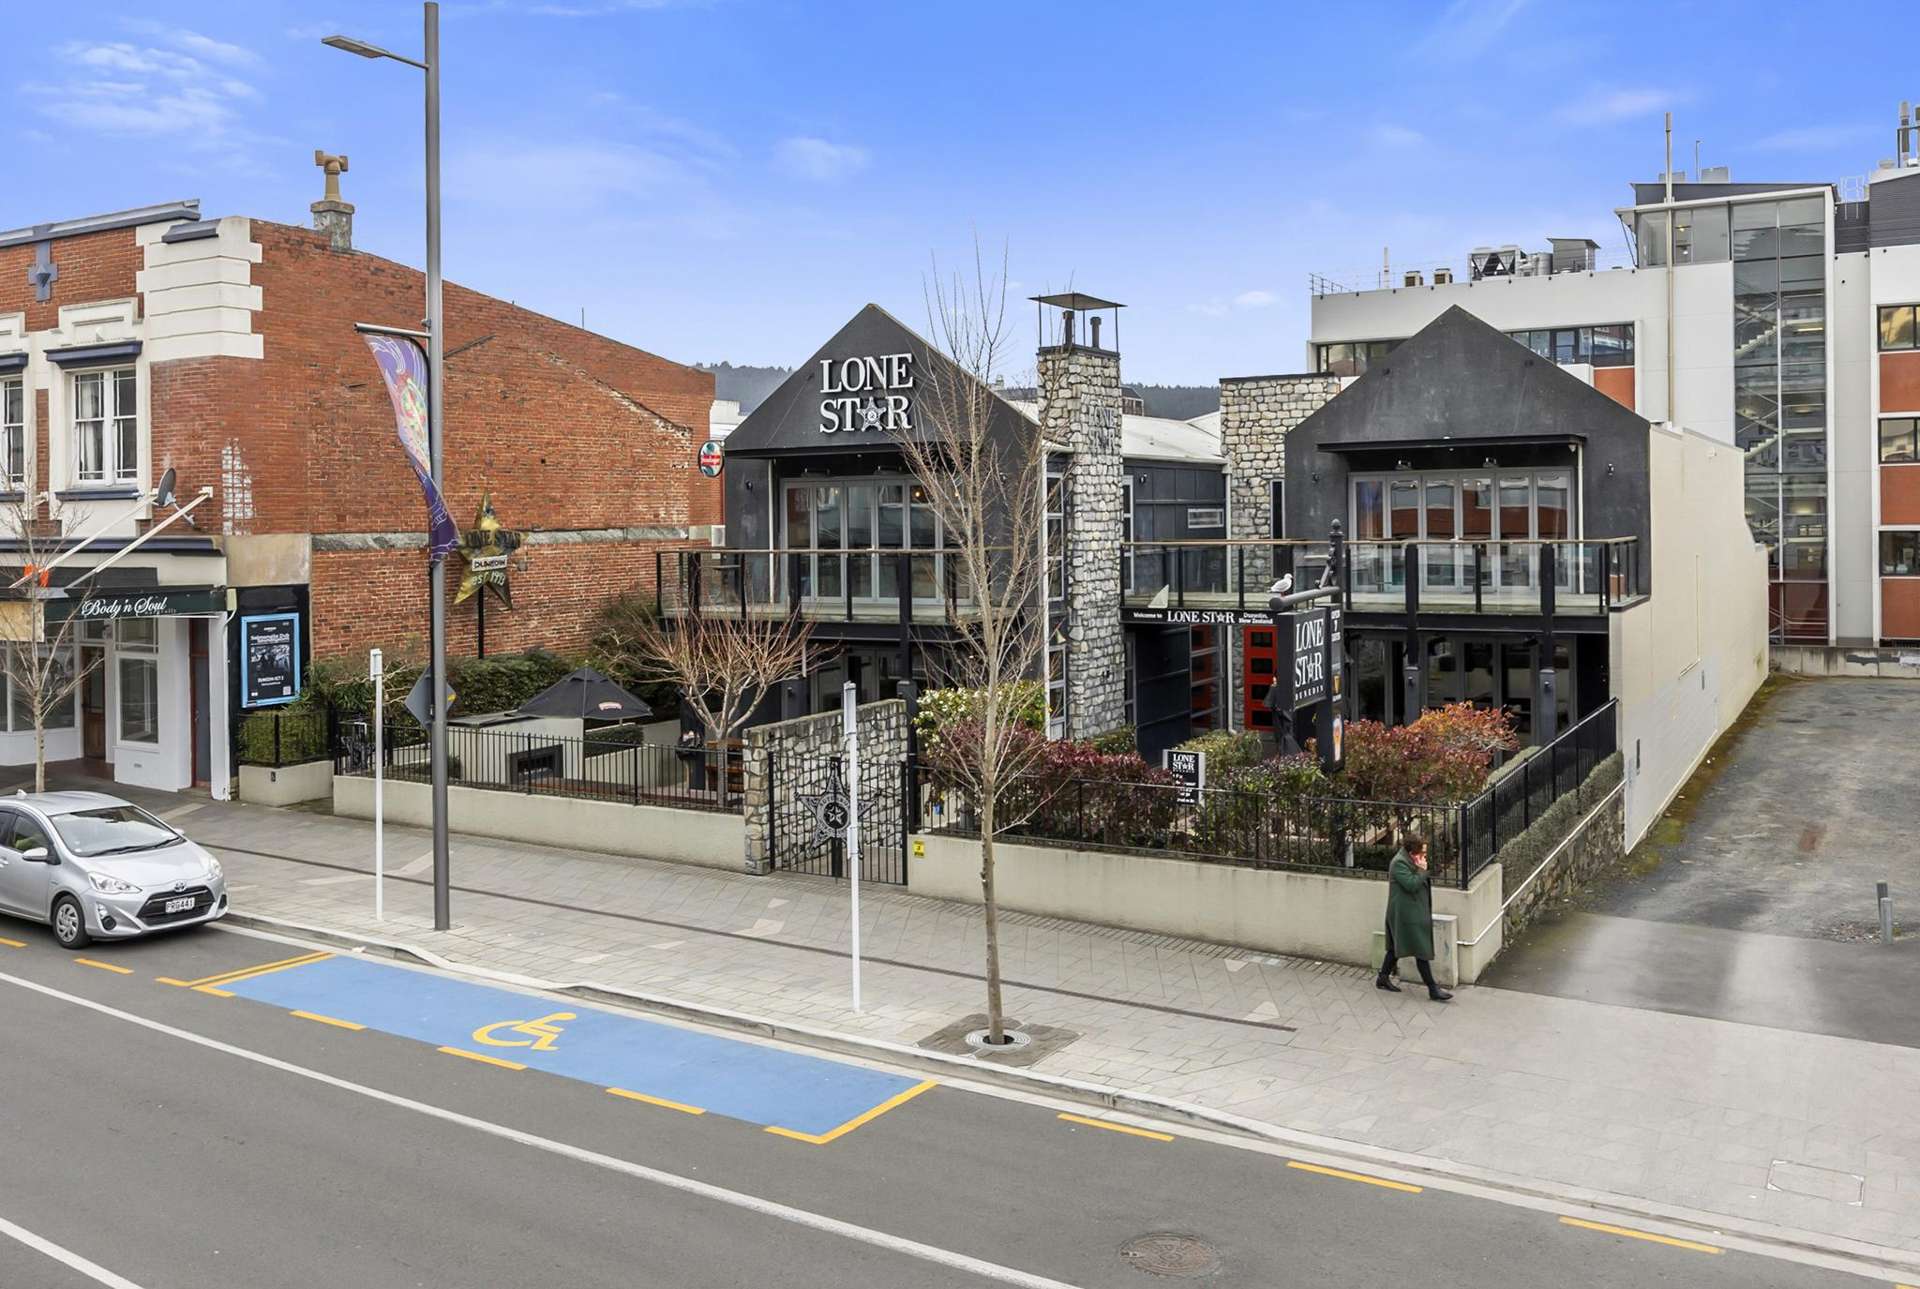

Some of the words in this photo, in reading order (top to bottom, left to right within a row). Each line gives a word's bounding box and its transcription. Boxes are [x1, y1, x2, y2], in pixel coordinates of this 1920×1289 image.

[820, 353, 914, 393] LONE
[81, 599, 121, 619] Body
[134, 596, 168, 617] Soul
[1167, 610, 1200, 623] LONE
[1295, 618, 1324, 652] LONE
[1172, 753, 1196, 763] LONE
